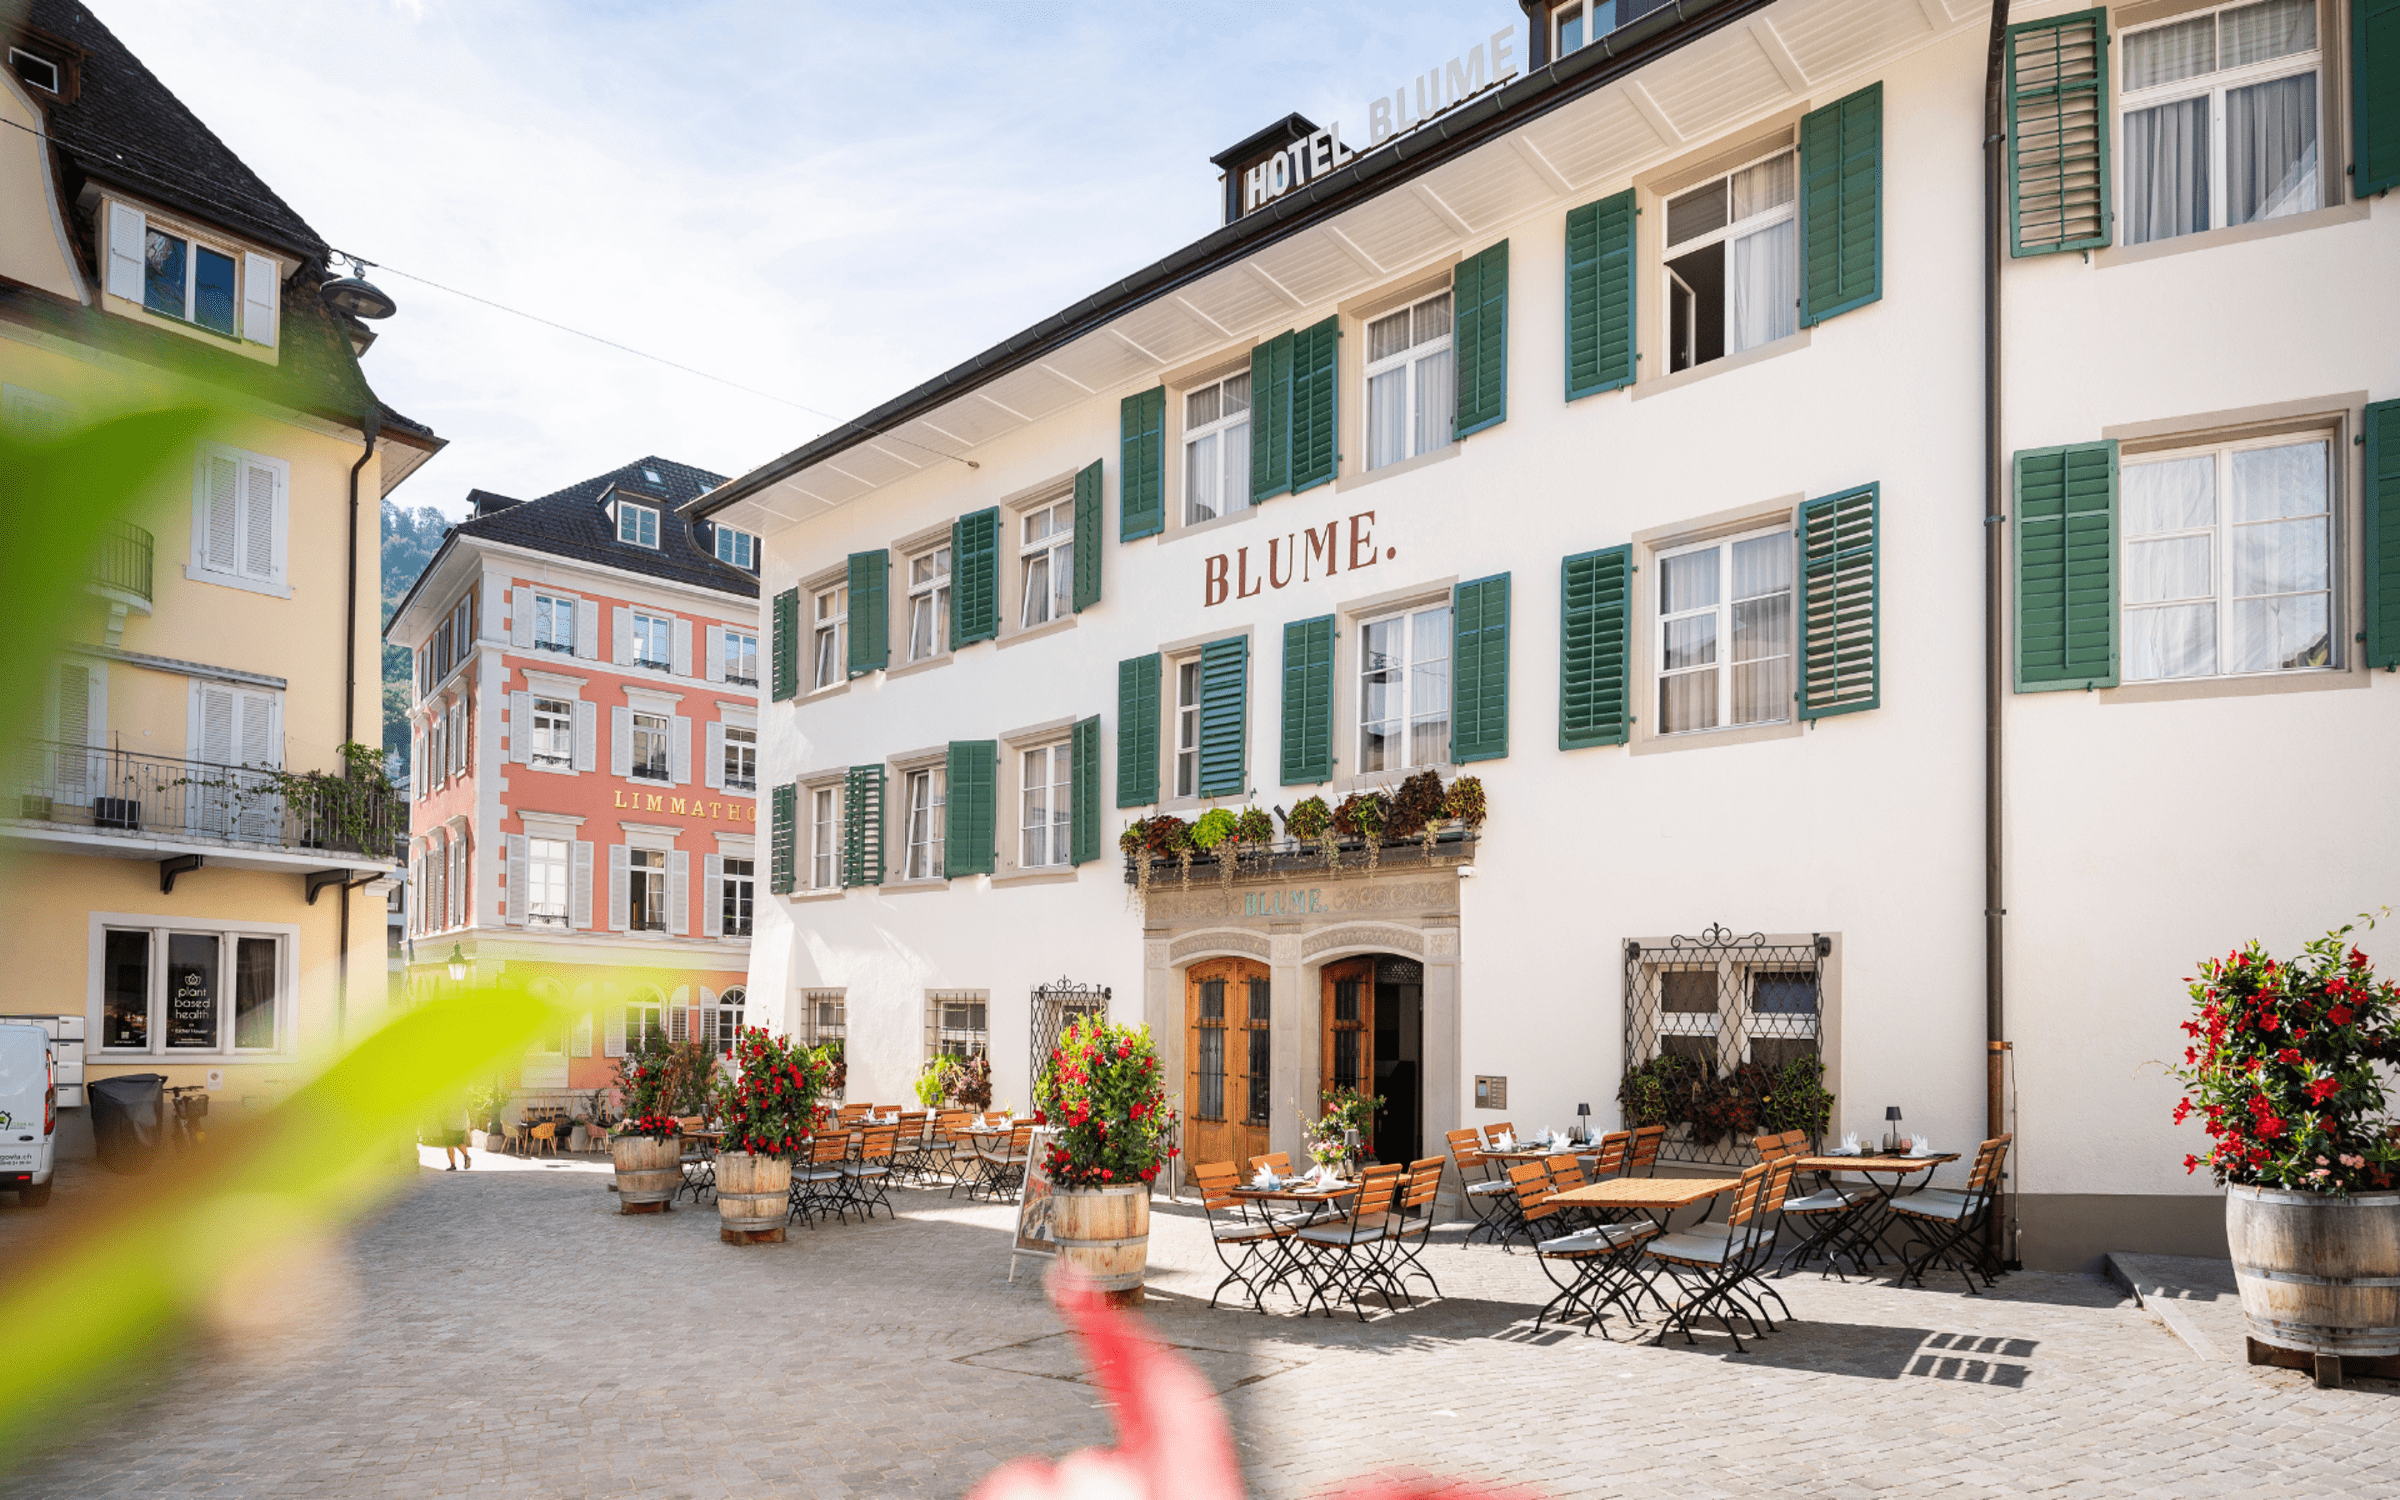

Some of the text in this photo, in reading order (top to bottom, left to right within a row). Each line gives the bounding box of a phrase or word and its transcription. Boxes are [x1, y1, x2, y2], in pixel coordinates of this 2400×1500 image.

[1248, 24, 1517, 210] HOTEL BLUME
[1204, 510, 1396, 607] BLUME.
[1245, 888, 1328, 916] BLUME.
[178, 986, 207, 998] plant
[174, 997, 210, 1008] based
[175, 1008, 209, 1019] health
